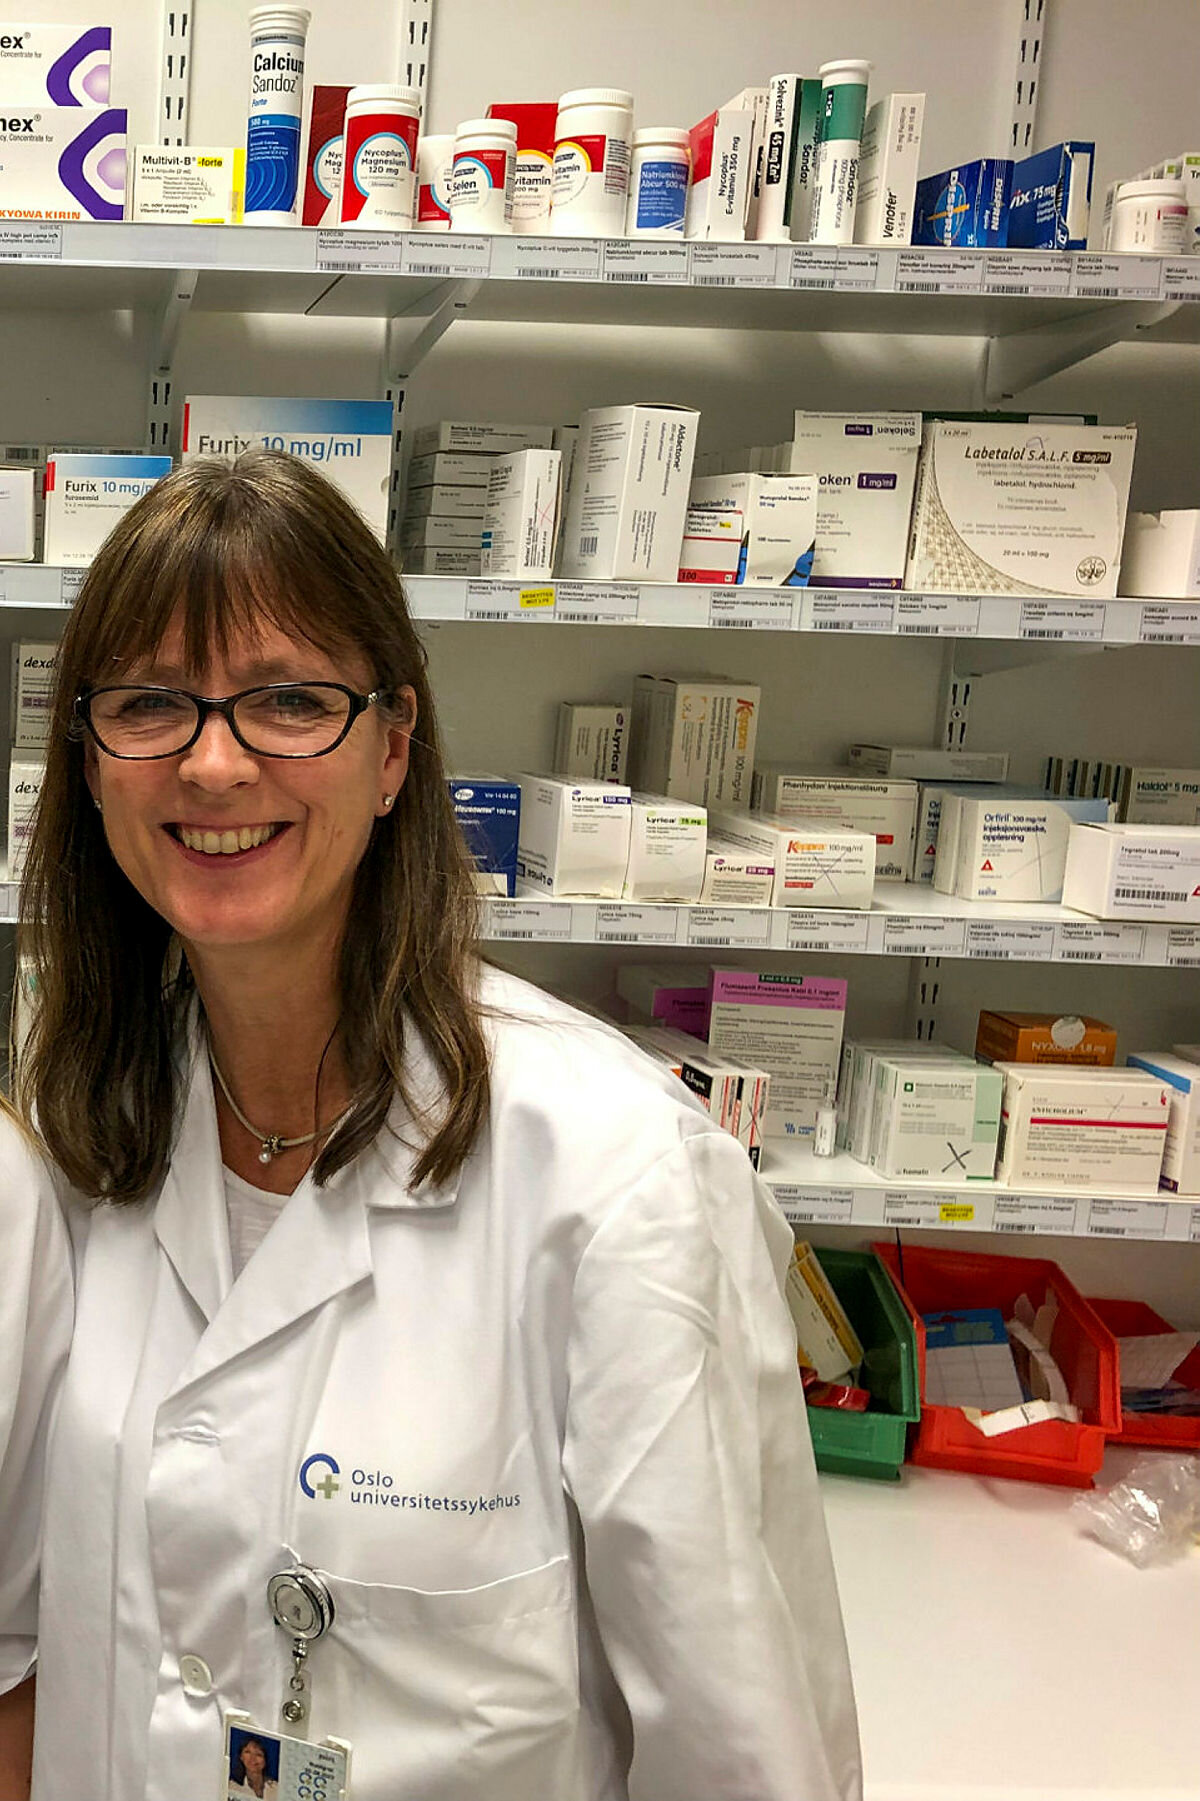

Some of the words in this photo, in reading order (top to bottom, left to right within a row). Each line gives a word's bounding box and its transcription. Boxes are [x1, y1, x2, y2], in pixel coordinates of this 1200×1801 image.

[252, 98, 268, 107] Forte
[198, 157, 223, 167] -forte
[361, 158, 406, 167] Magnesium
[453, 179, 477, 191] Selen
[516, 177, 551, 186] vitamin
[641, 180, 663, 188] Abcur
[726, 172, 737, 215] E-vitamin
[1032, 188, 1044, 200] 75
[991, 178, 1002, 230] DISPRIN
[45, 211, 81, 219] KIRIN
[199, 435, 250, 454] Furix
[288, 436, 362, 463] mg/ml
[965, 446, 1026, 460] Labetalol
[1028, 450, 1069, 462] S.A.L.F.
[1083, 453, 1109, 464] mg/ml
[64, 480, 97, 493] Furix
[869, 477, 894, 488] mg/ml
[827, 783, 889, 794] Injektionslösung
[1182, 784, 1199, 793] mg
[982, 833, 1025, 842] oppløsning
[843, 844, 864, 855] mg/ml
[352, 1469, 394, 1488] Oslo
[350, 1489, 521, 1516] universitetssykehus
